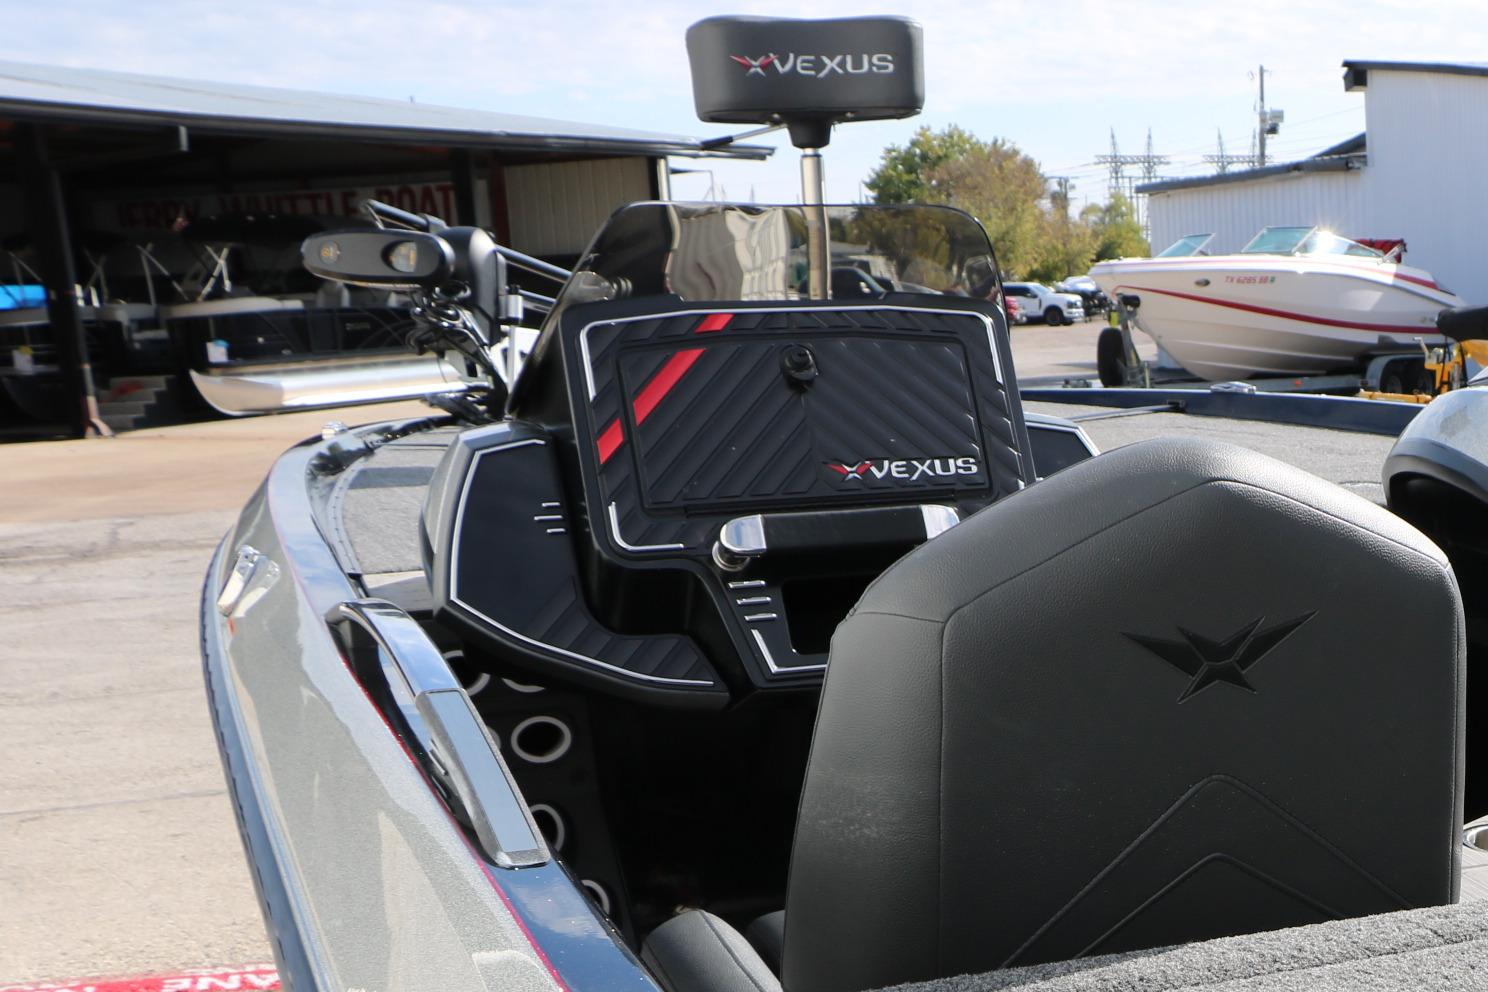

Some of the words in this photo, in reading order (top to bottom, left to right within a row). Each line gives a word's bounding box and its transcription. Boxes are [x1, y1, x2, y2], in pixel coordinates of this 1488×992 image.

[769, 53, 894, 78] VEXUS
[865, 457, 978, 481] VEXUS
[160, 973, 280, 992] ANE
